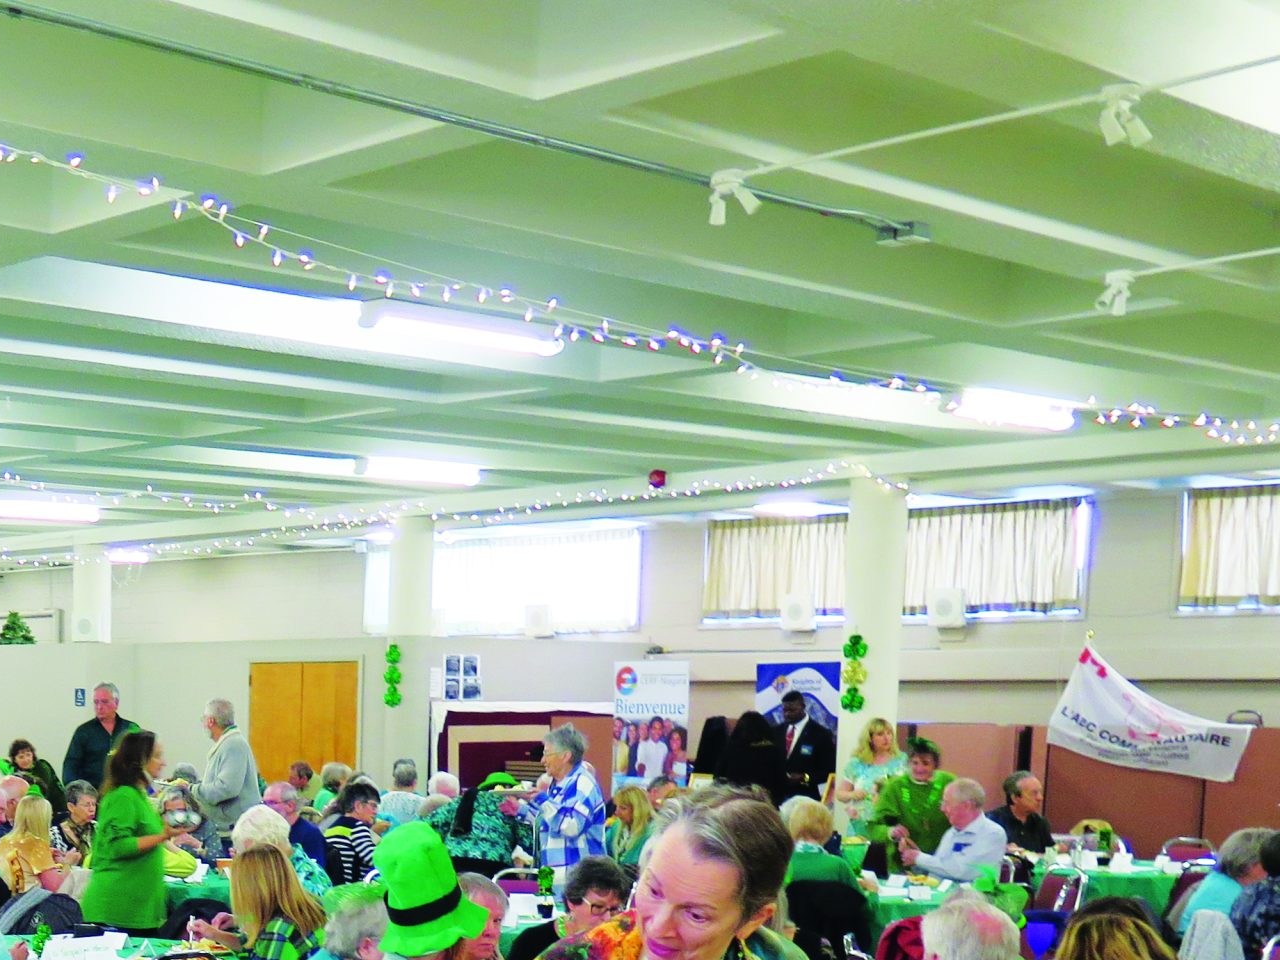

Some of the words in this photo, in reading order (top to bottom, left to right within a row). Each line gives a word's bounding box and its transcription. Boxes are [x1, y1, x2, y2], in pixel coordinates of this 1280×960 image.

[616, 698, 685, 714] Bienvenue
[1061, 706, 1097, 732] L'ABC
[1099, 729, 1233, 750] COMAUTAIRE
